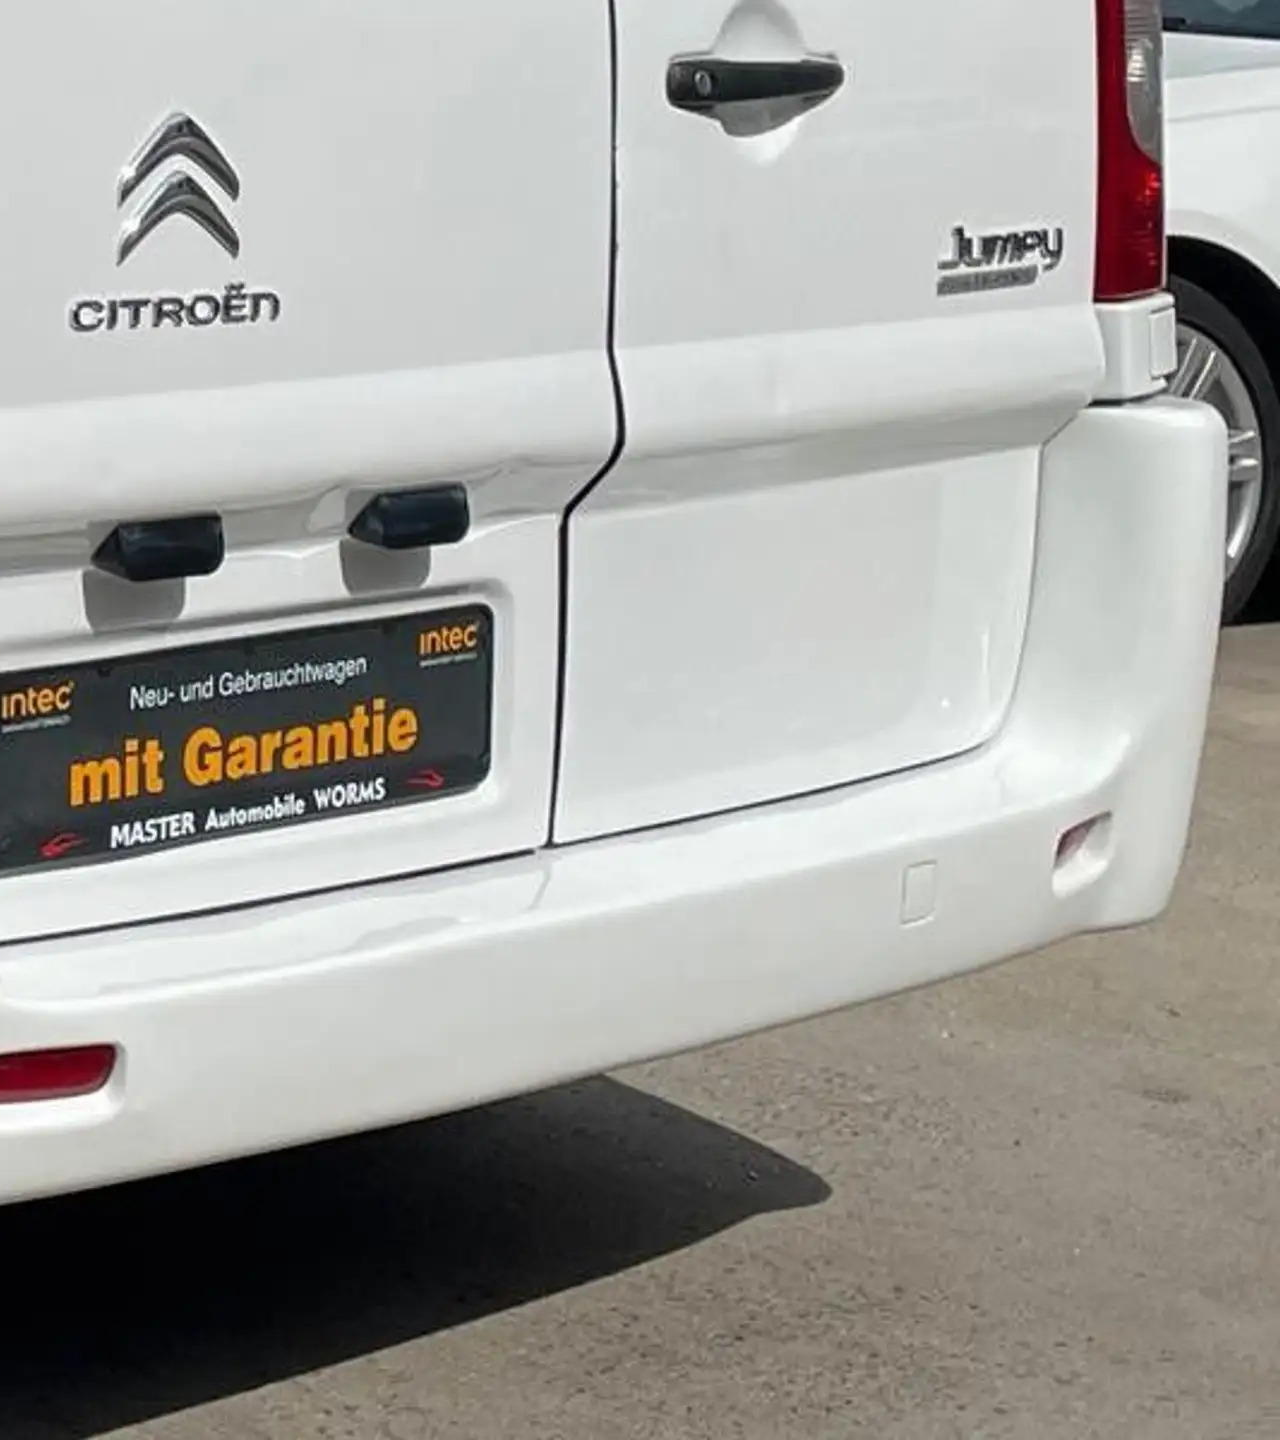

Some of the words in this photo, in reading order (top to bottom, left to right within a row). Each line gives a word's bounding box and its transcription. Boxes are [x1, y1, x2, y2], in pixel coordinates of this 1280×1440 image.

[938, 226, 1063, 272] Jumpy
[1, 684, 72, 718] intec
[130, 686, 175, 711] Neu-
[180, 675, 213, 702] und
[218, 656, 367, 696] Gebrauchtwagen
[69, 736, 164, 807] mit
[183, 697, 419, 787] Garantie
[110, 811, 196, 850] MASTER
[205, 793, 306, 832] Automobile
[313, 777, 387, 810] WORMS
